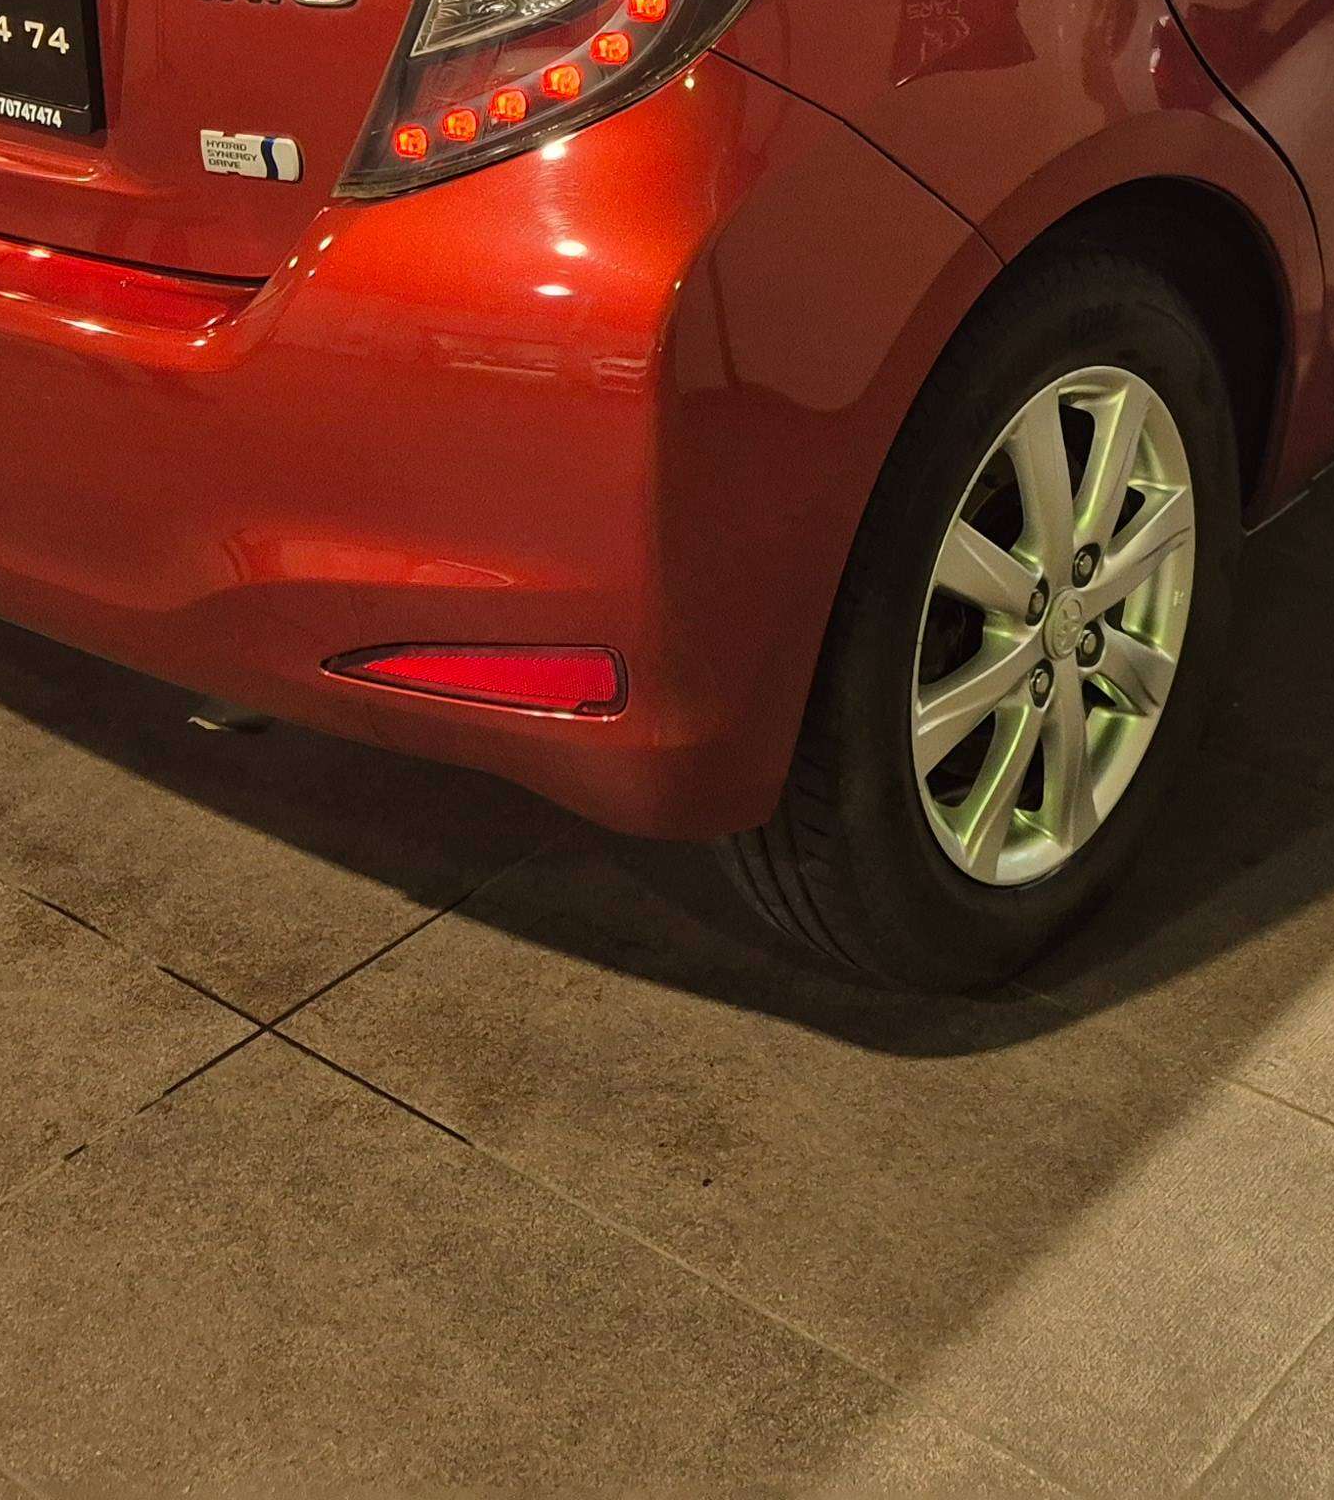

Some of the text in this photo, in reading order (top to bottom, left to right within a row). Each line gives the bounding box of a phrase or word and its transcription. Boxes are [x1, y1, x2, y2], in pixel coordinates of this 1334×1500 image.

[24, 20, 69, 54] 74
[207, 149, 258, 162] SYNERGY
[208, 159, 242, 169] DRIVE
